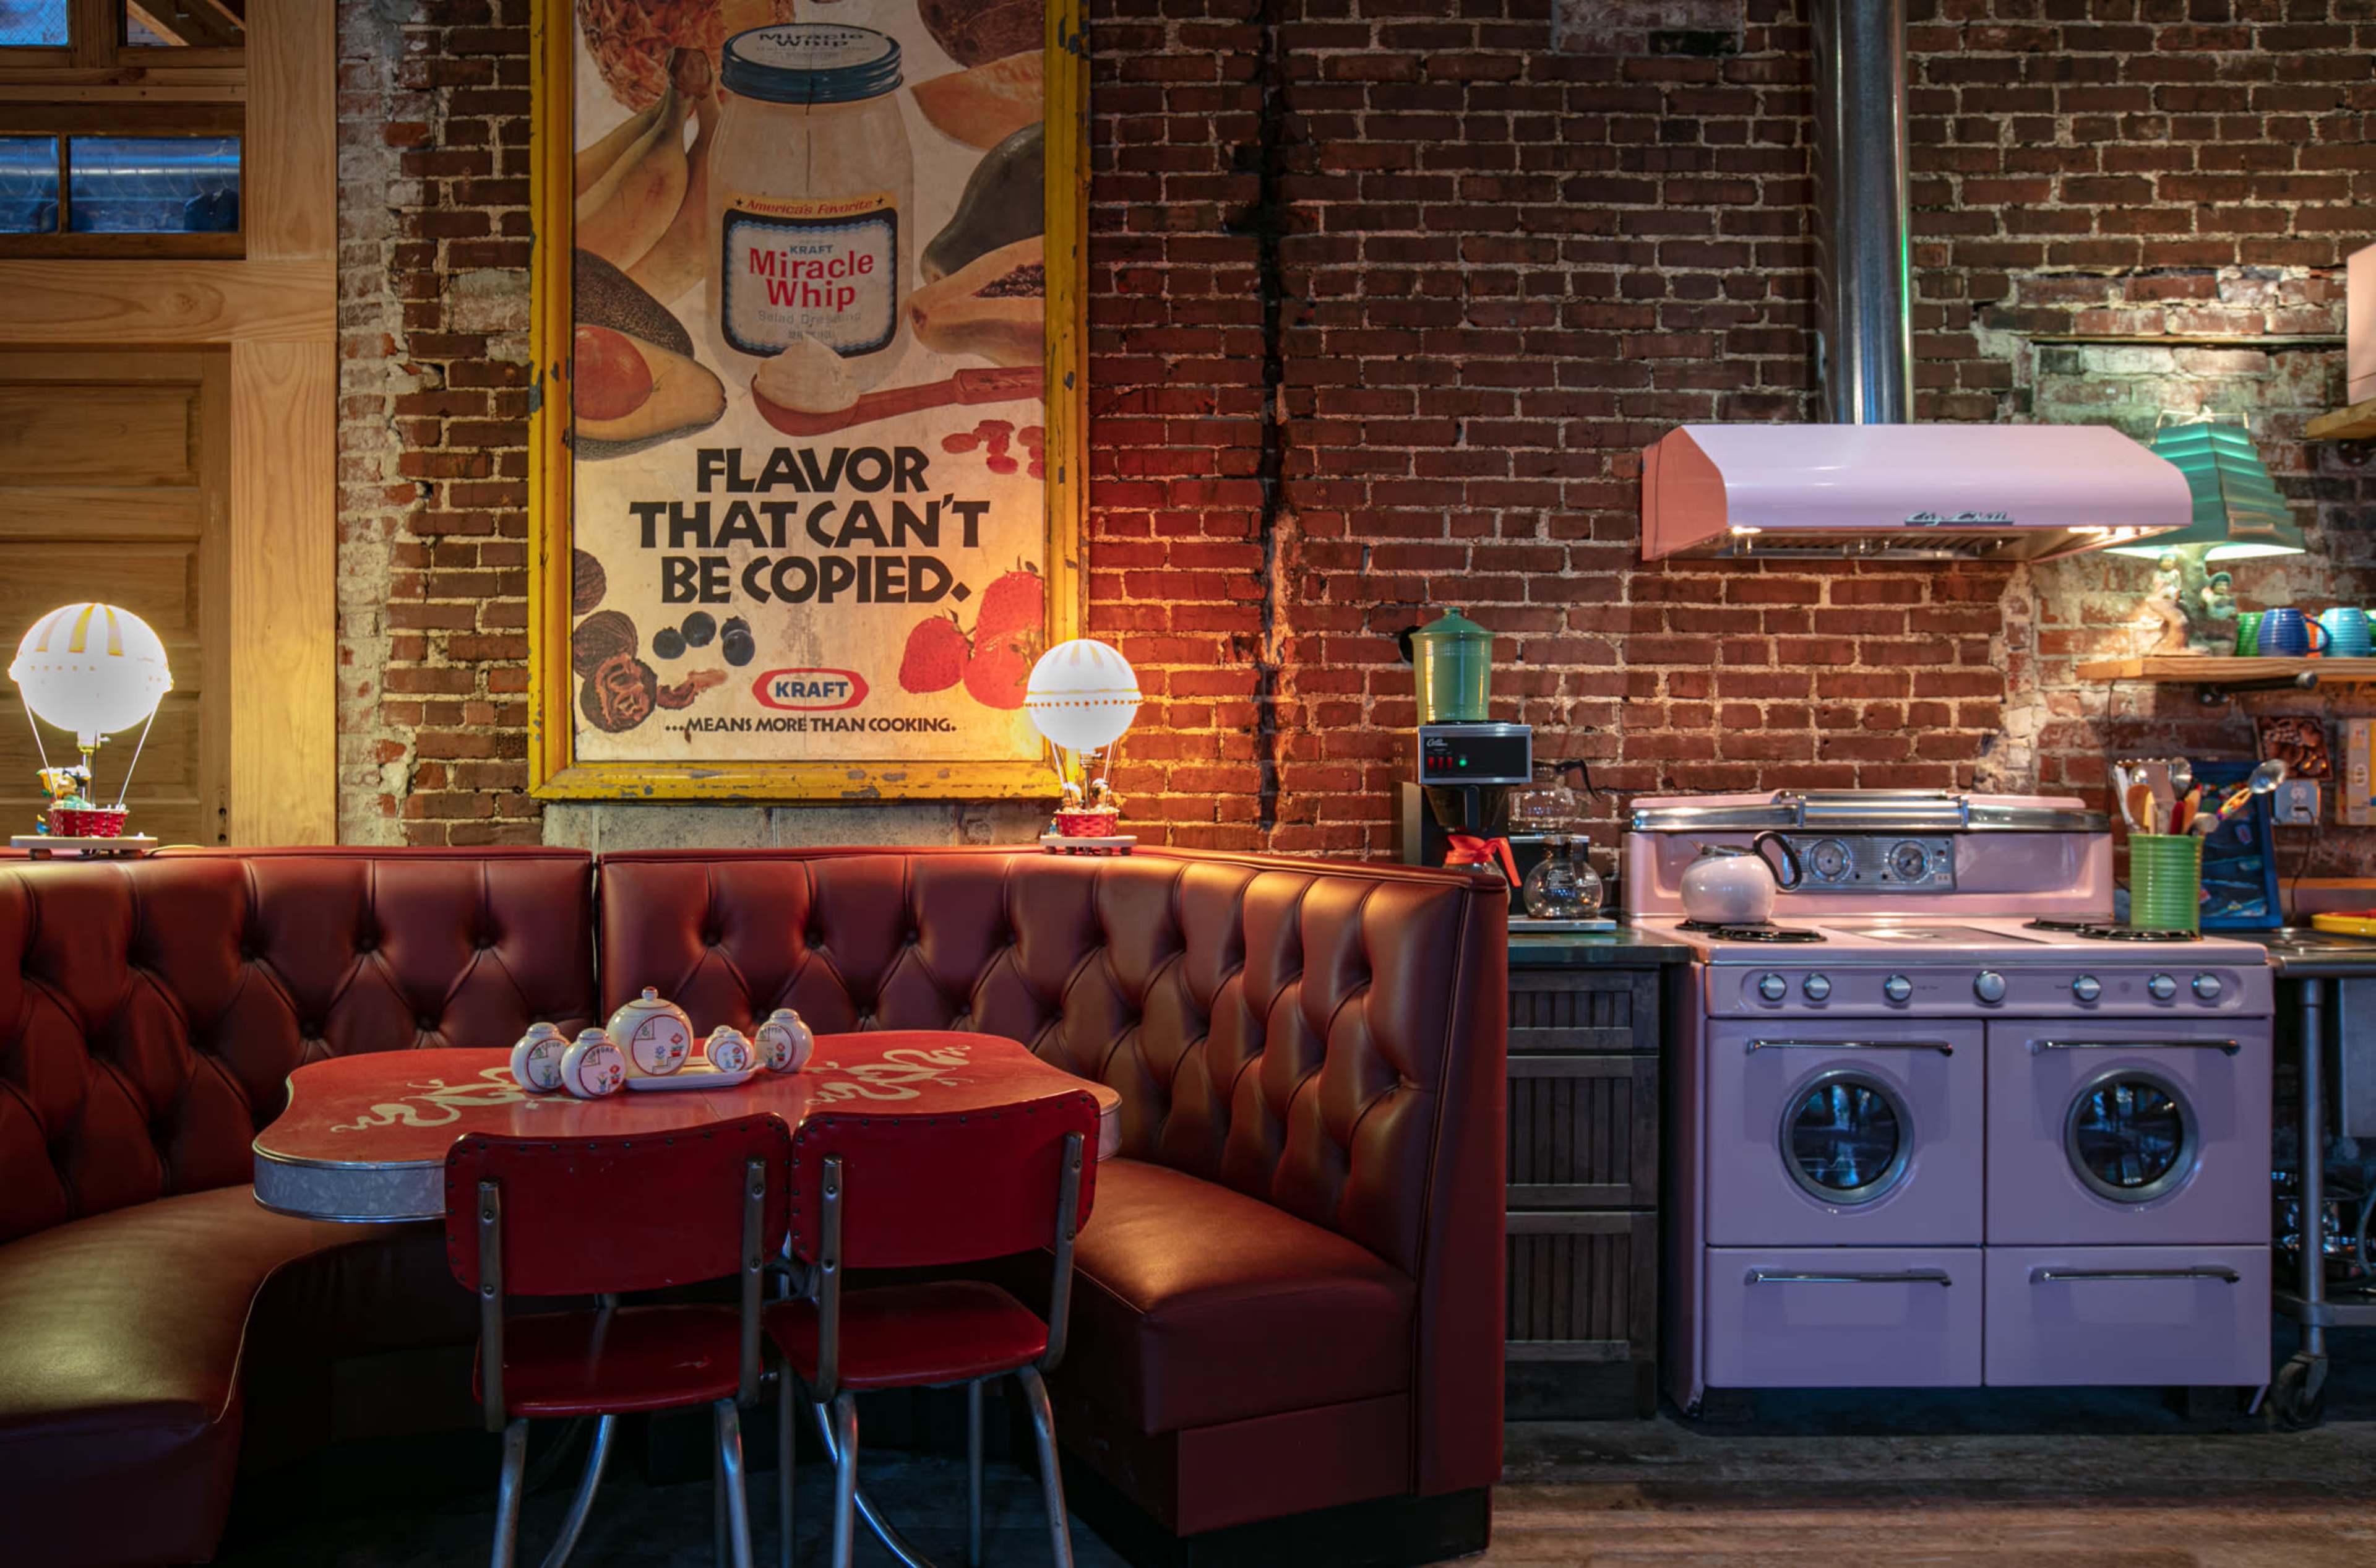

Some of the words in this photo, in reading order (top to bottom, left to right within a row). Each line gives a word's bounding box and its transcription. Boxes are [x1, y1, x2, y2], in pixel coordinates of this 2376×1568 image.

[817, 200, 874, 215] Favorite
[749, 248, 874, 280] Miracle
[789, 244, 834, 255] KRAFT
[766, 278, 856, 312] Whip
[697, 446, 929, 493] FLAVOR
[629, 501, 798, 548] THAT
[806, 493, 991, 548] CAN'T
[662, 556, 731, 603] BE
[742, 556, 971, 603] COPIED.
[775, 681, 850, 699] KRAFT
[755, 717, 807, 732] MORE
[810, 717, 866, 732] THAN
[868, 717, 957, 733] COOKING.
